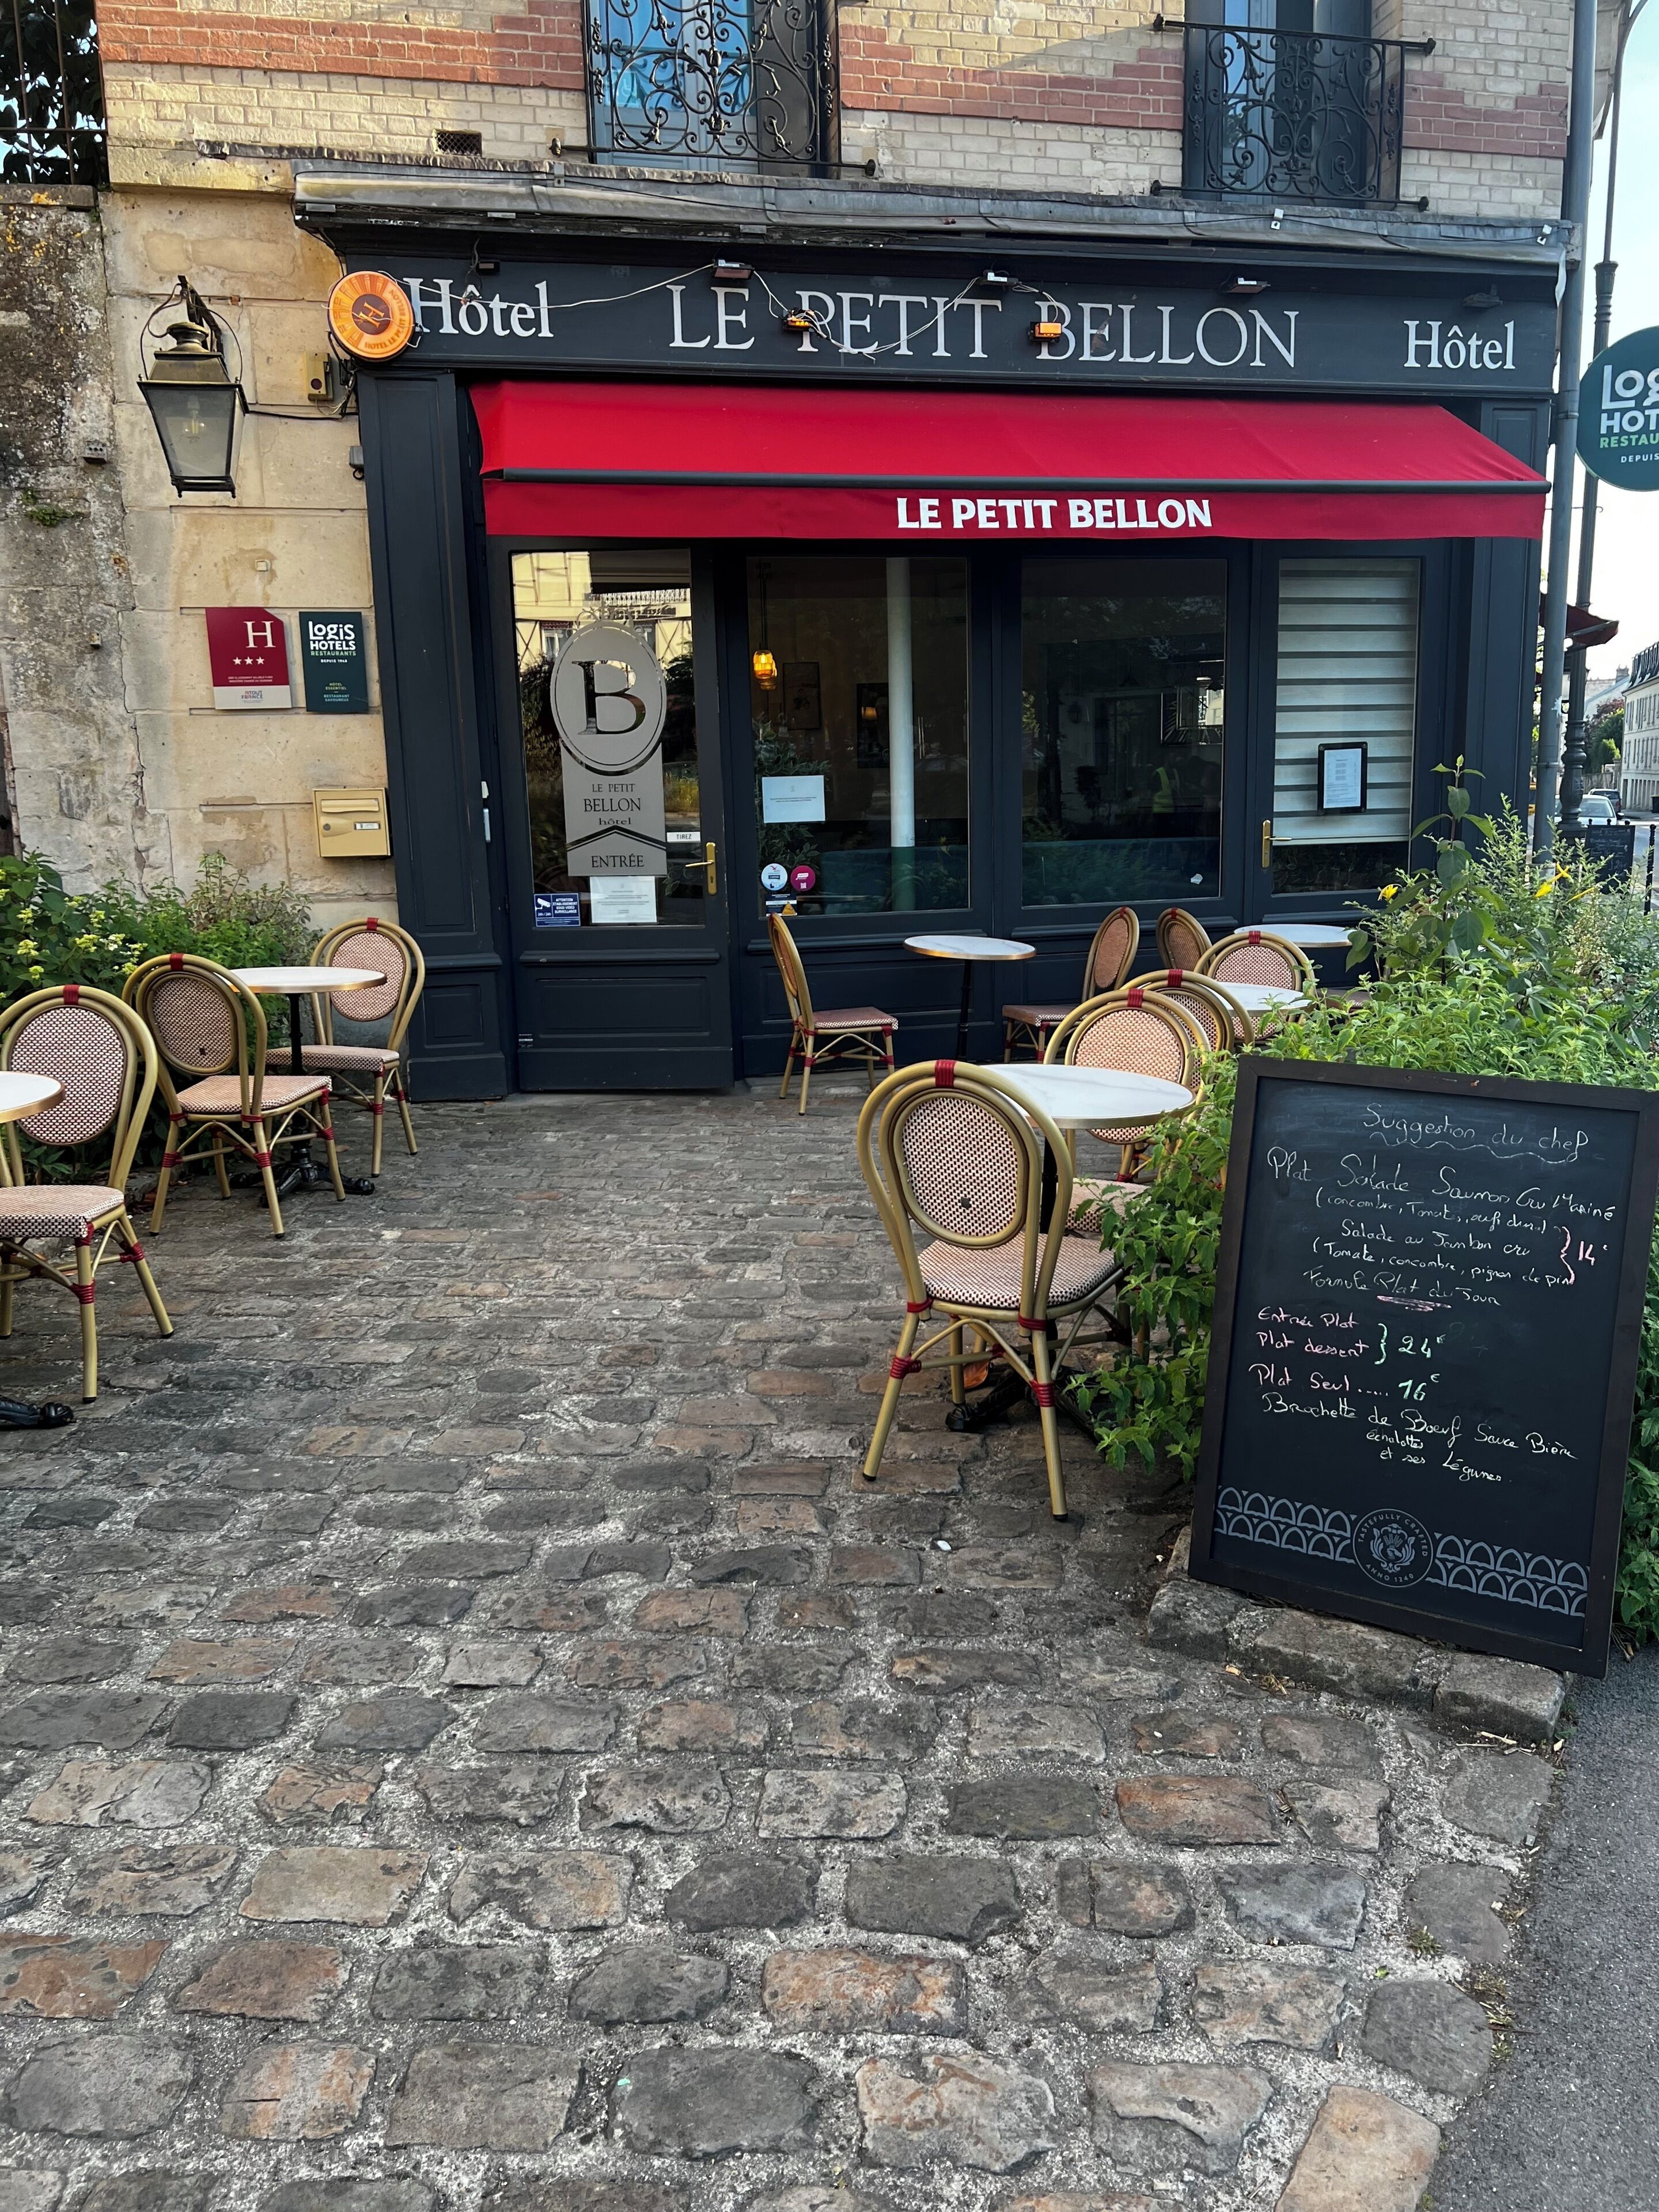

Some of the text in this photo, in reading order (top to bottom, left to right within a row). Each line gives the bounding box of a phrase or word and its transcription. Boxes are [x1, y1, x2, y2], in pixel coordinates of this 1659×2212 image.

[403, 278, 554, 338] Hôtel
[666, 285, 1299, 368] LE PETIT BELLON
[1403, 320, 1515, 369] Hôtel
[896, 497, 1212, 528] LE PETIT BELLON
[243, 620, 276, 648] H
[310, 641, 356, 650] HOTELS
[571, 660, 646, 735] B
[592, 783, 635, 793] LE PETIT
[584, 798, 641, 812] BELLON
[599, 817, 631, 825] hôtel
[591, 853, 645, 868] ENTRÉE
[1363, 1103, 1475, 1144] Suggestion
[1492, 1123, 1524, 1145] du
[1267, 1146, 1312, 1181] Plat
[1338, 1154, 1410, 1191] Salade
[1431, 1166, 1510, 1203] Saumon
[1341, 1218, 1396, 1243] Salade
[1432, 1231, 1492, 1249] Jambon
[1503, 1243, 1531, 1256] cru
[1304, 1265, 1371, 1290] Formule
[1374, 1271, 1419, 1293] Plat
[1429, 1280, 1453, 1297] du
[1522, 1267, 1541, 1283] de
[1256, 1330, 1295, 1349] Plat
[1249, 1363, 1293, 1386] Plat
[1368, 1406, 1392, 1426] de
[1475, 1423, 1520, 1448] Sauce
[1380, 1446, 1393, 1459] et
[1402, 1455, 1426, 1464] ses
[1358, 1513, 1428, 1556] TASTEFULLY CRAFTED
[1366, 1564, 1414, 1582] ANNO 1240
